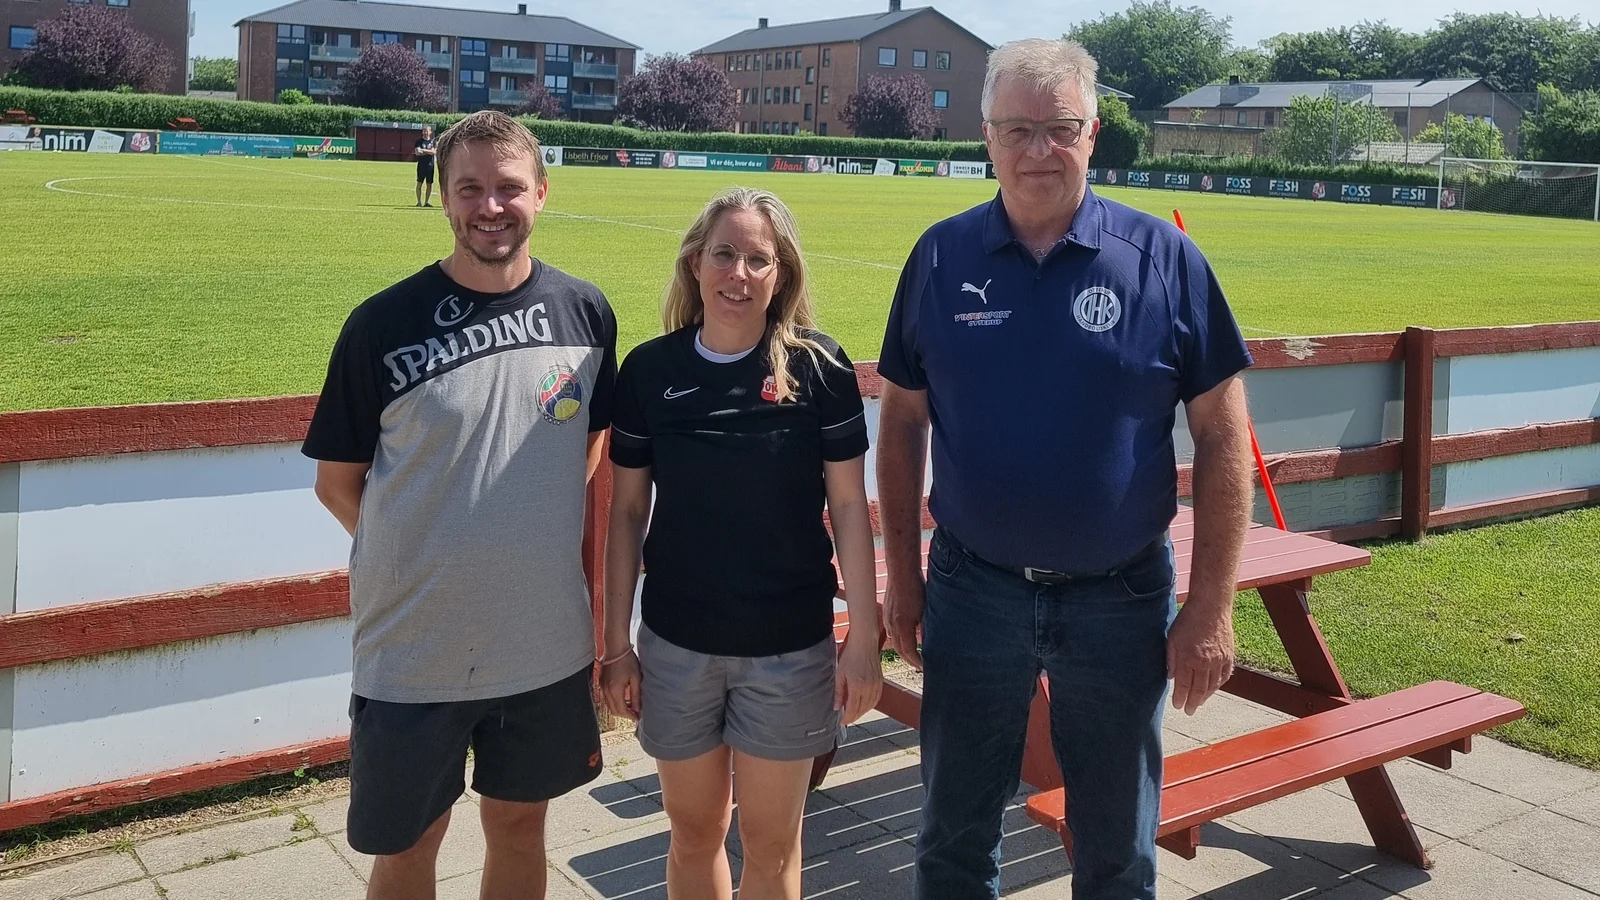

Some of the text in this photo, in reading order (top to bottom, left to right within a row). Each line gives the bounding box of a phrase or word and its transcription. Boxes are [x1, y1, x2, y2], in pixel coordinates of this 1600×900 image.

[44, 130, 86, 151] nim
[296, 144, 320, 152] FAXE
[323, 145, 353, 154] KONDI
[564, 151, 589, 160] Lisbeth
[839, 159, 861, 174] nim
[971, 167, 983, 175] BH
[1127, 171, 1150, 182] FOSS
[1226, 177, 1252, 189] FOSS
[1341, 184, 1371, 197] FOSS
[383, 302, 553, 392] SPALDING
